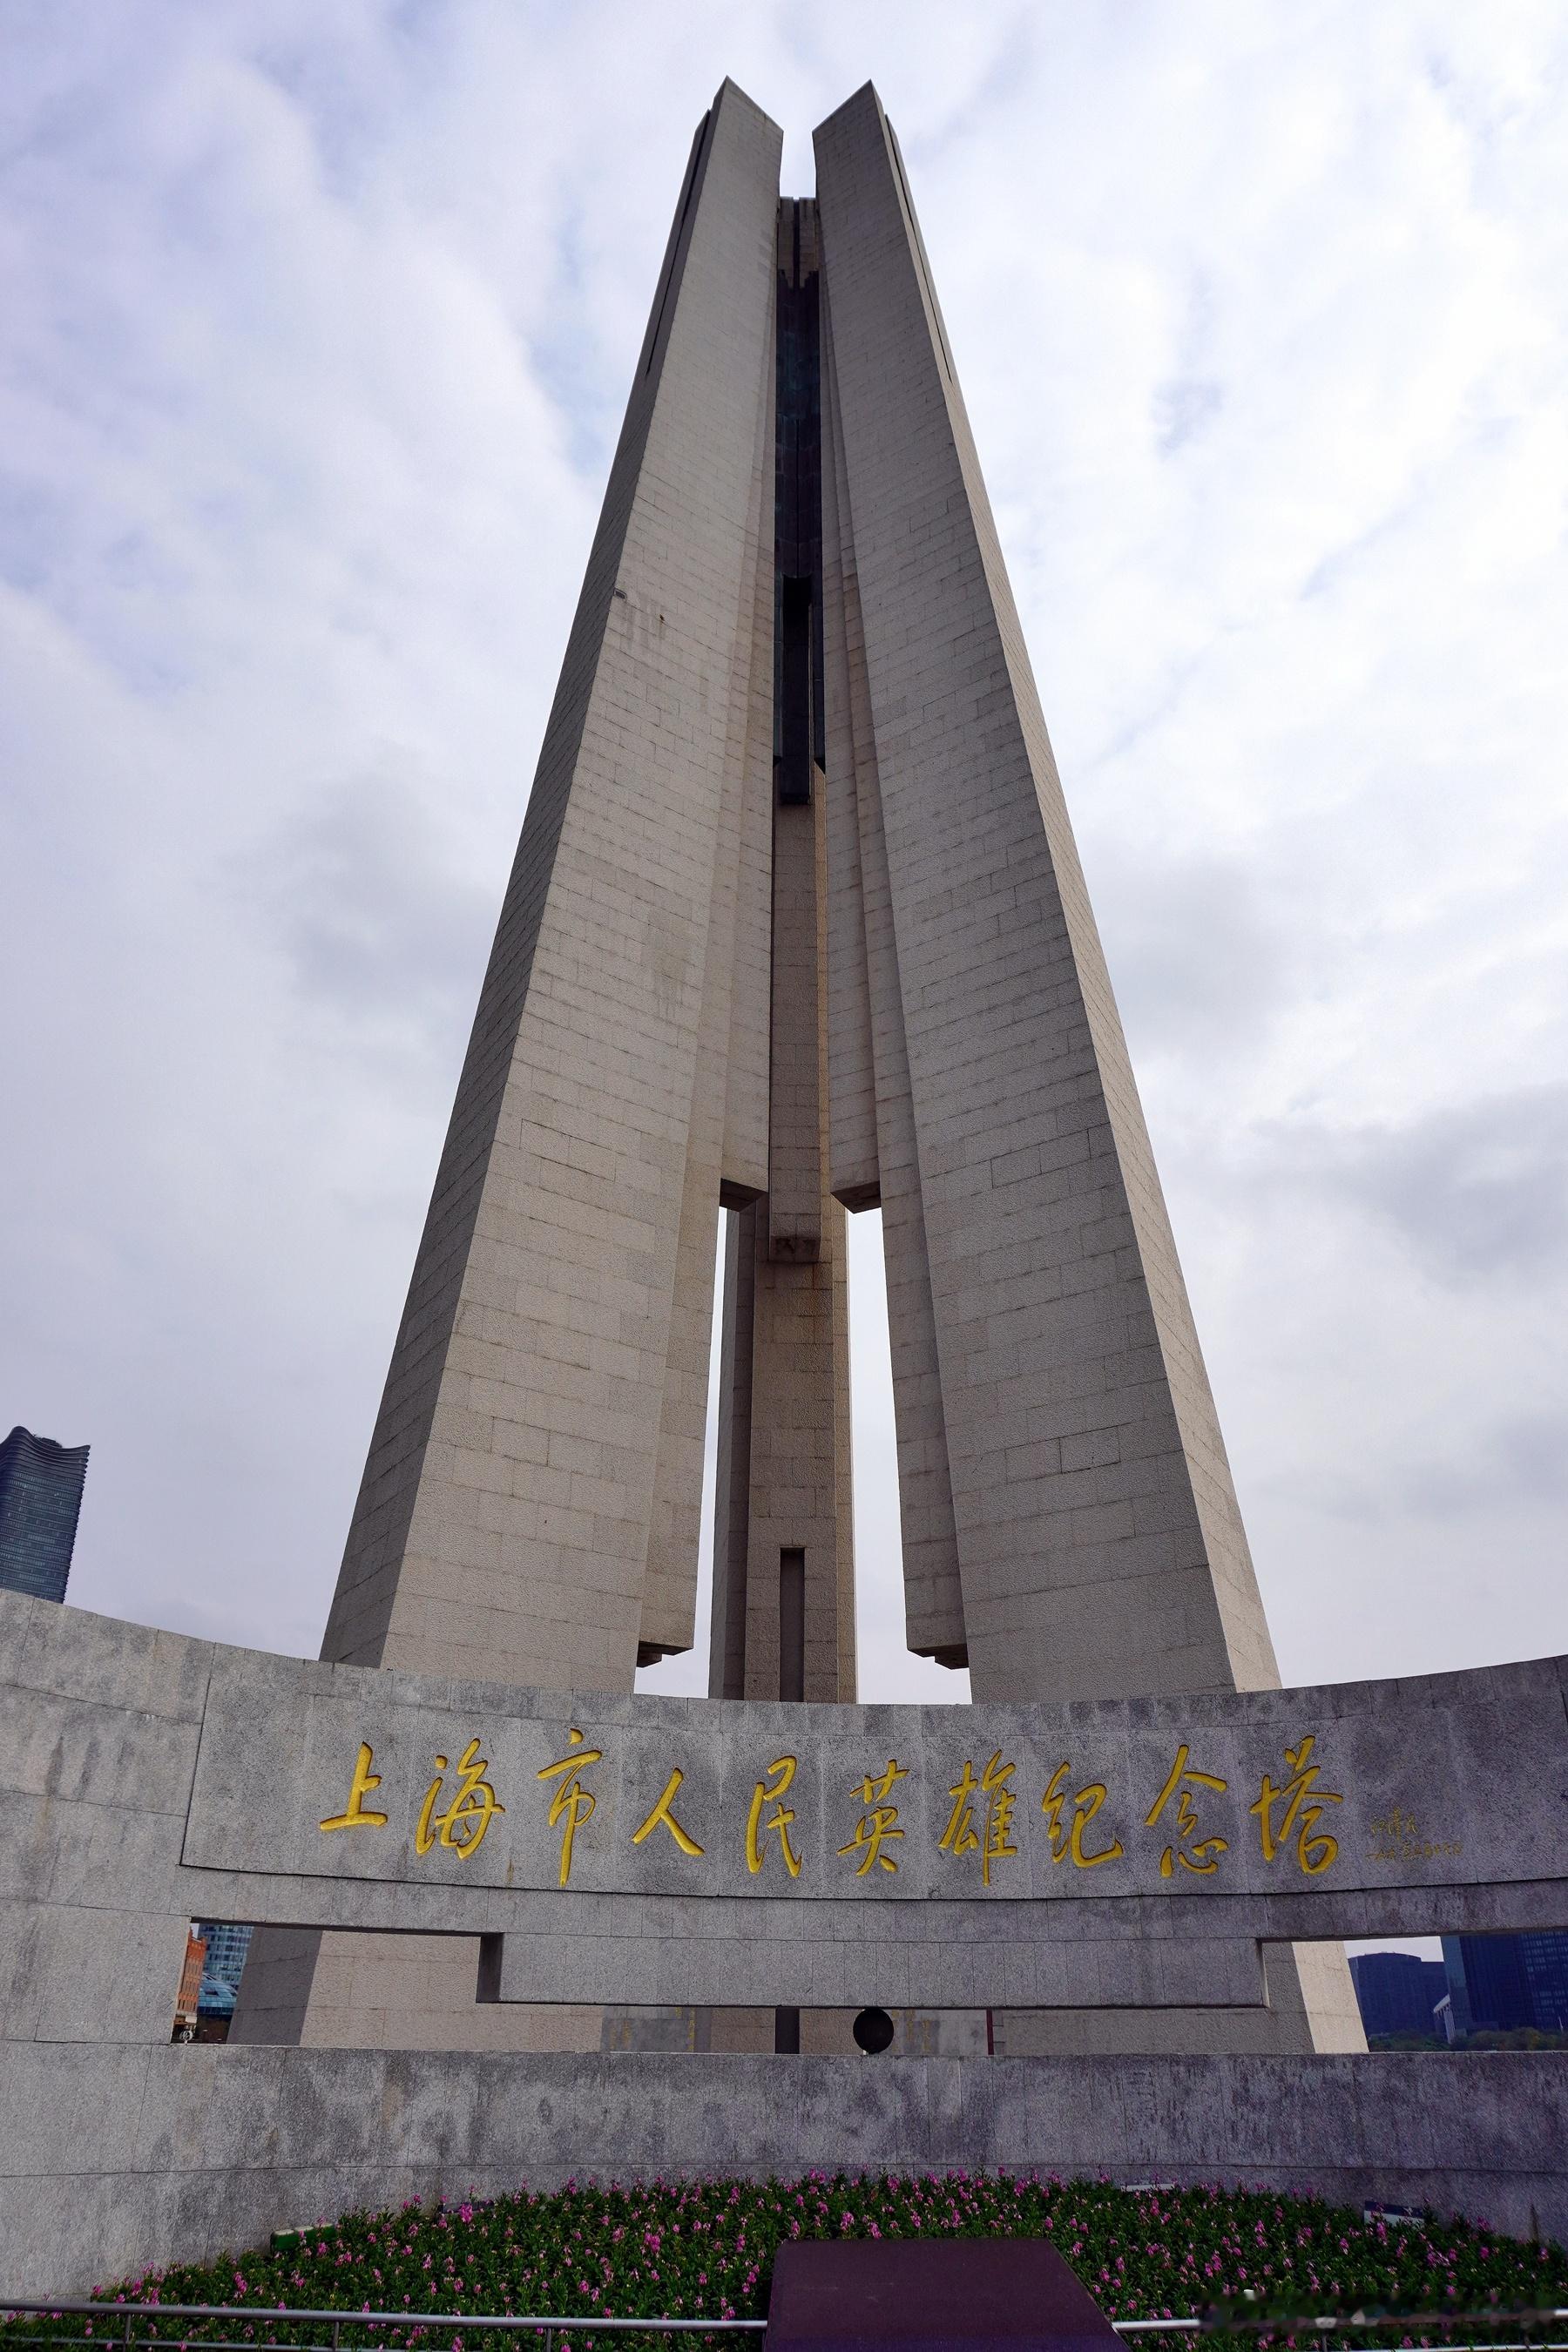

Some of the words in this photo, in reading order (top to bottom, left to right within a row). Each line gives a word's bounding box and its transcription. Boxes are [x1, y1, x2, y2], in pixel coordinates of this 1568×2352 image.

[319, 1727, 1347, 1888] 上海市人民英雄纪念塔
